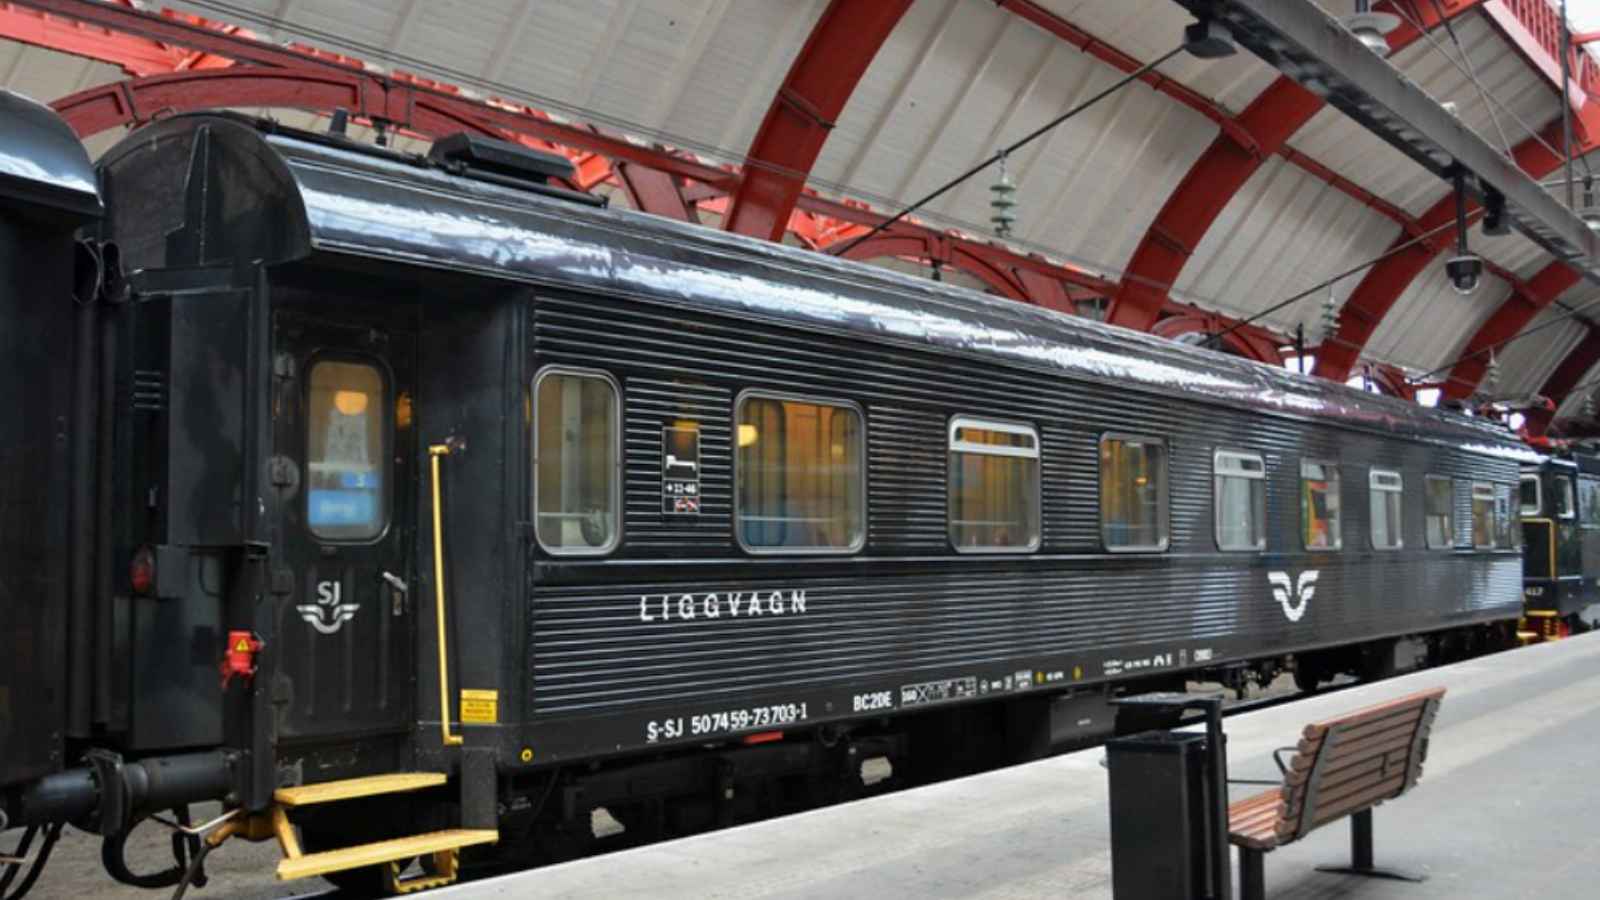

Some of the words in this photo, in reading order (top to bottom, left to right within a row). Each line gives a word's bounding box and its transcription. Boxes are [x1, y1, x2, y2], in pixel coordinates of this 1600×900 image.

[318, 581, 341, 607] SJ
[639, 589, 807, 622] LIGGVAGN
[646, 717, 684, 743] S-SJ
